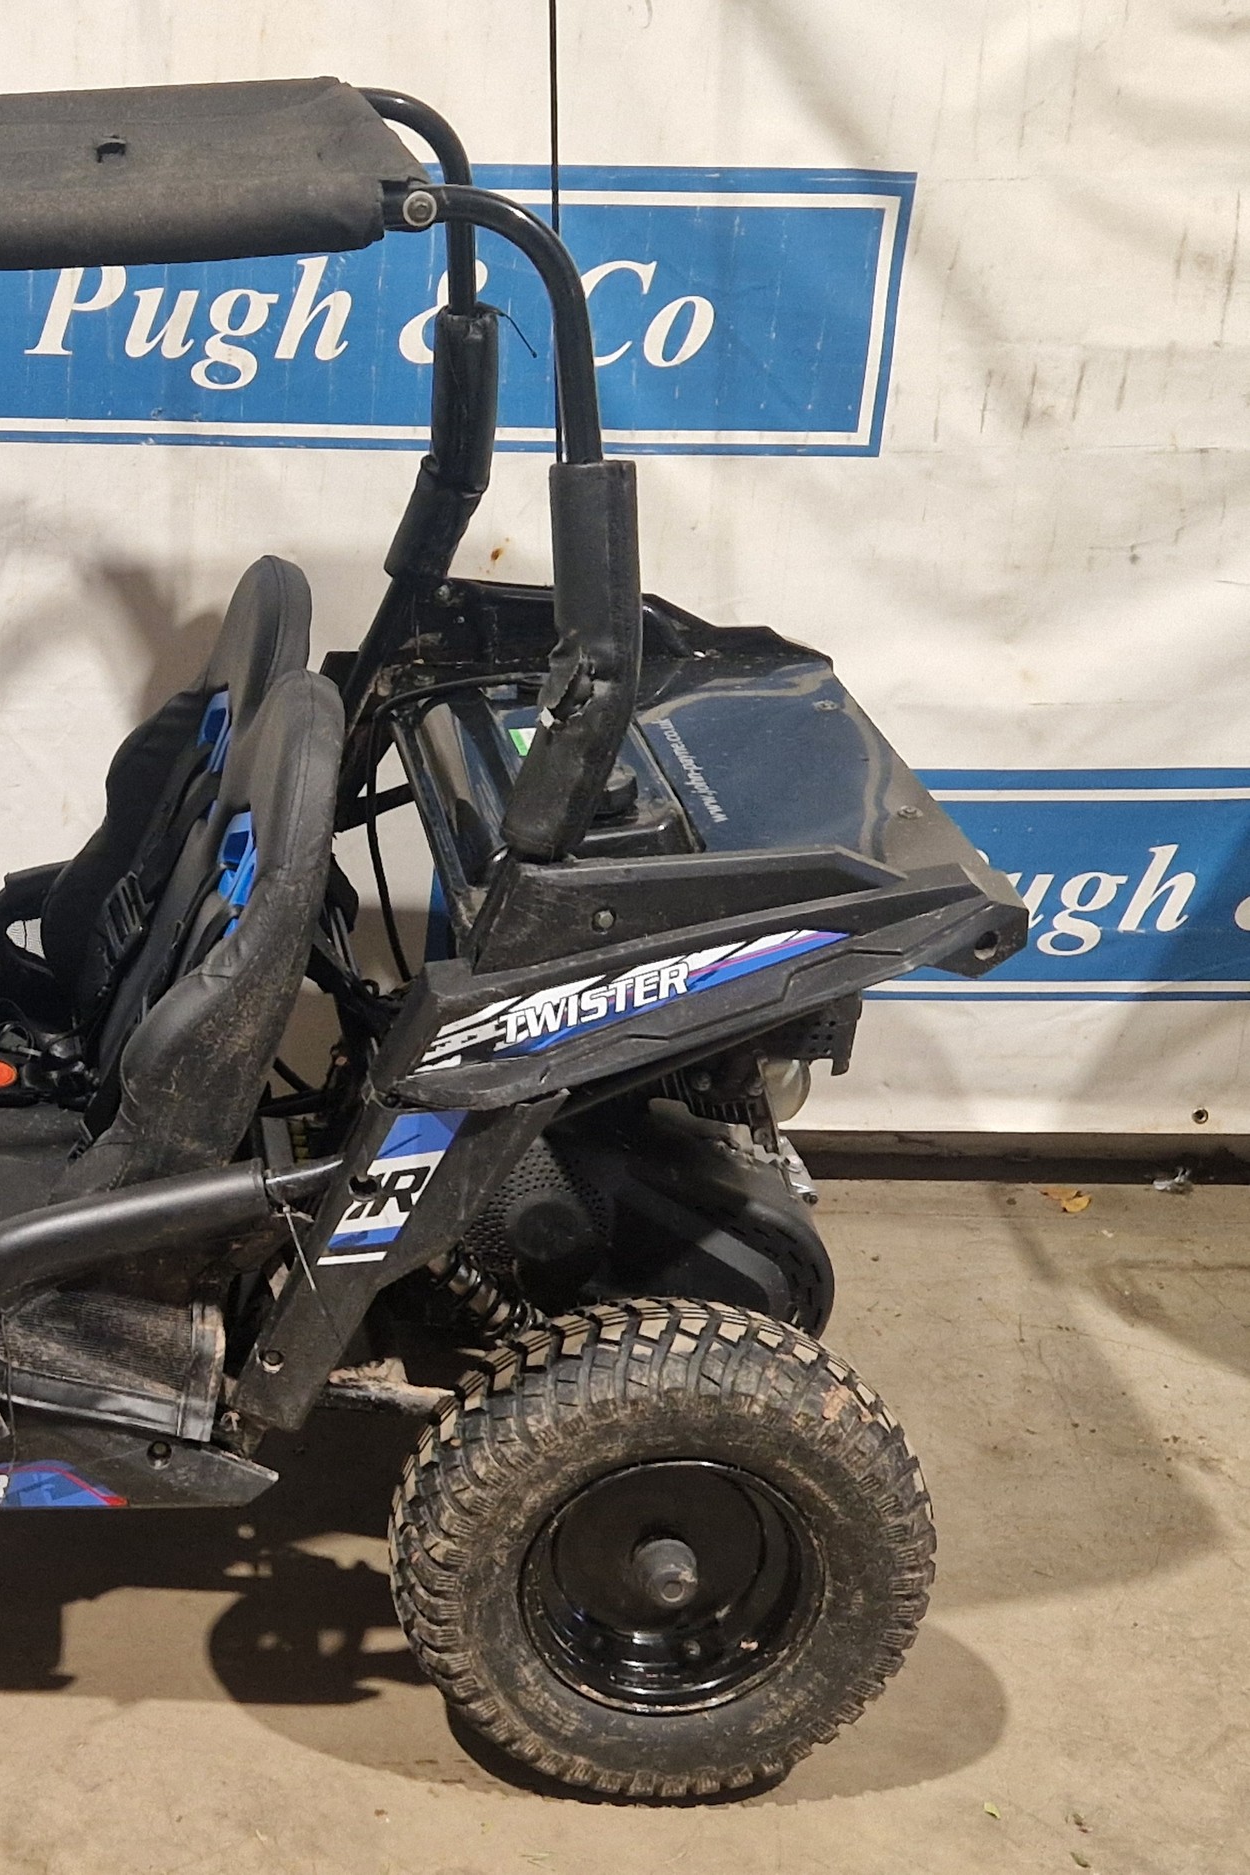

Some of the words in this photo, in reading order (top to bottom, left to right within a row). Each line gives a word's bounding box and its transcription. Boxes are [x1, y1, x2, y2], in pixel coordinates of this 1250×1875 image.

[24, 256, 352, 391] Pugh
[580, 260, 715, 368] Co
[974, 844, 1197, 957] ugh
[498, 961, 691, 1044] TWISTER
